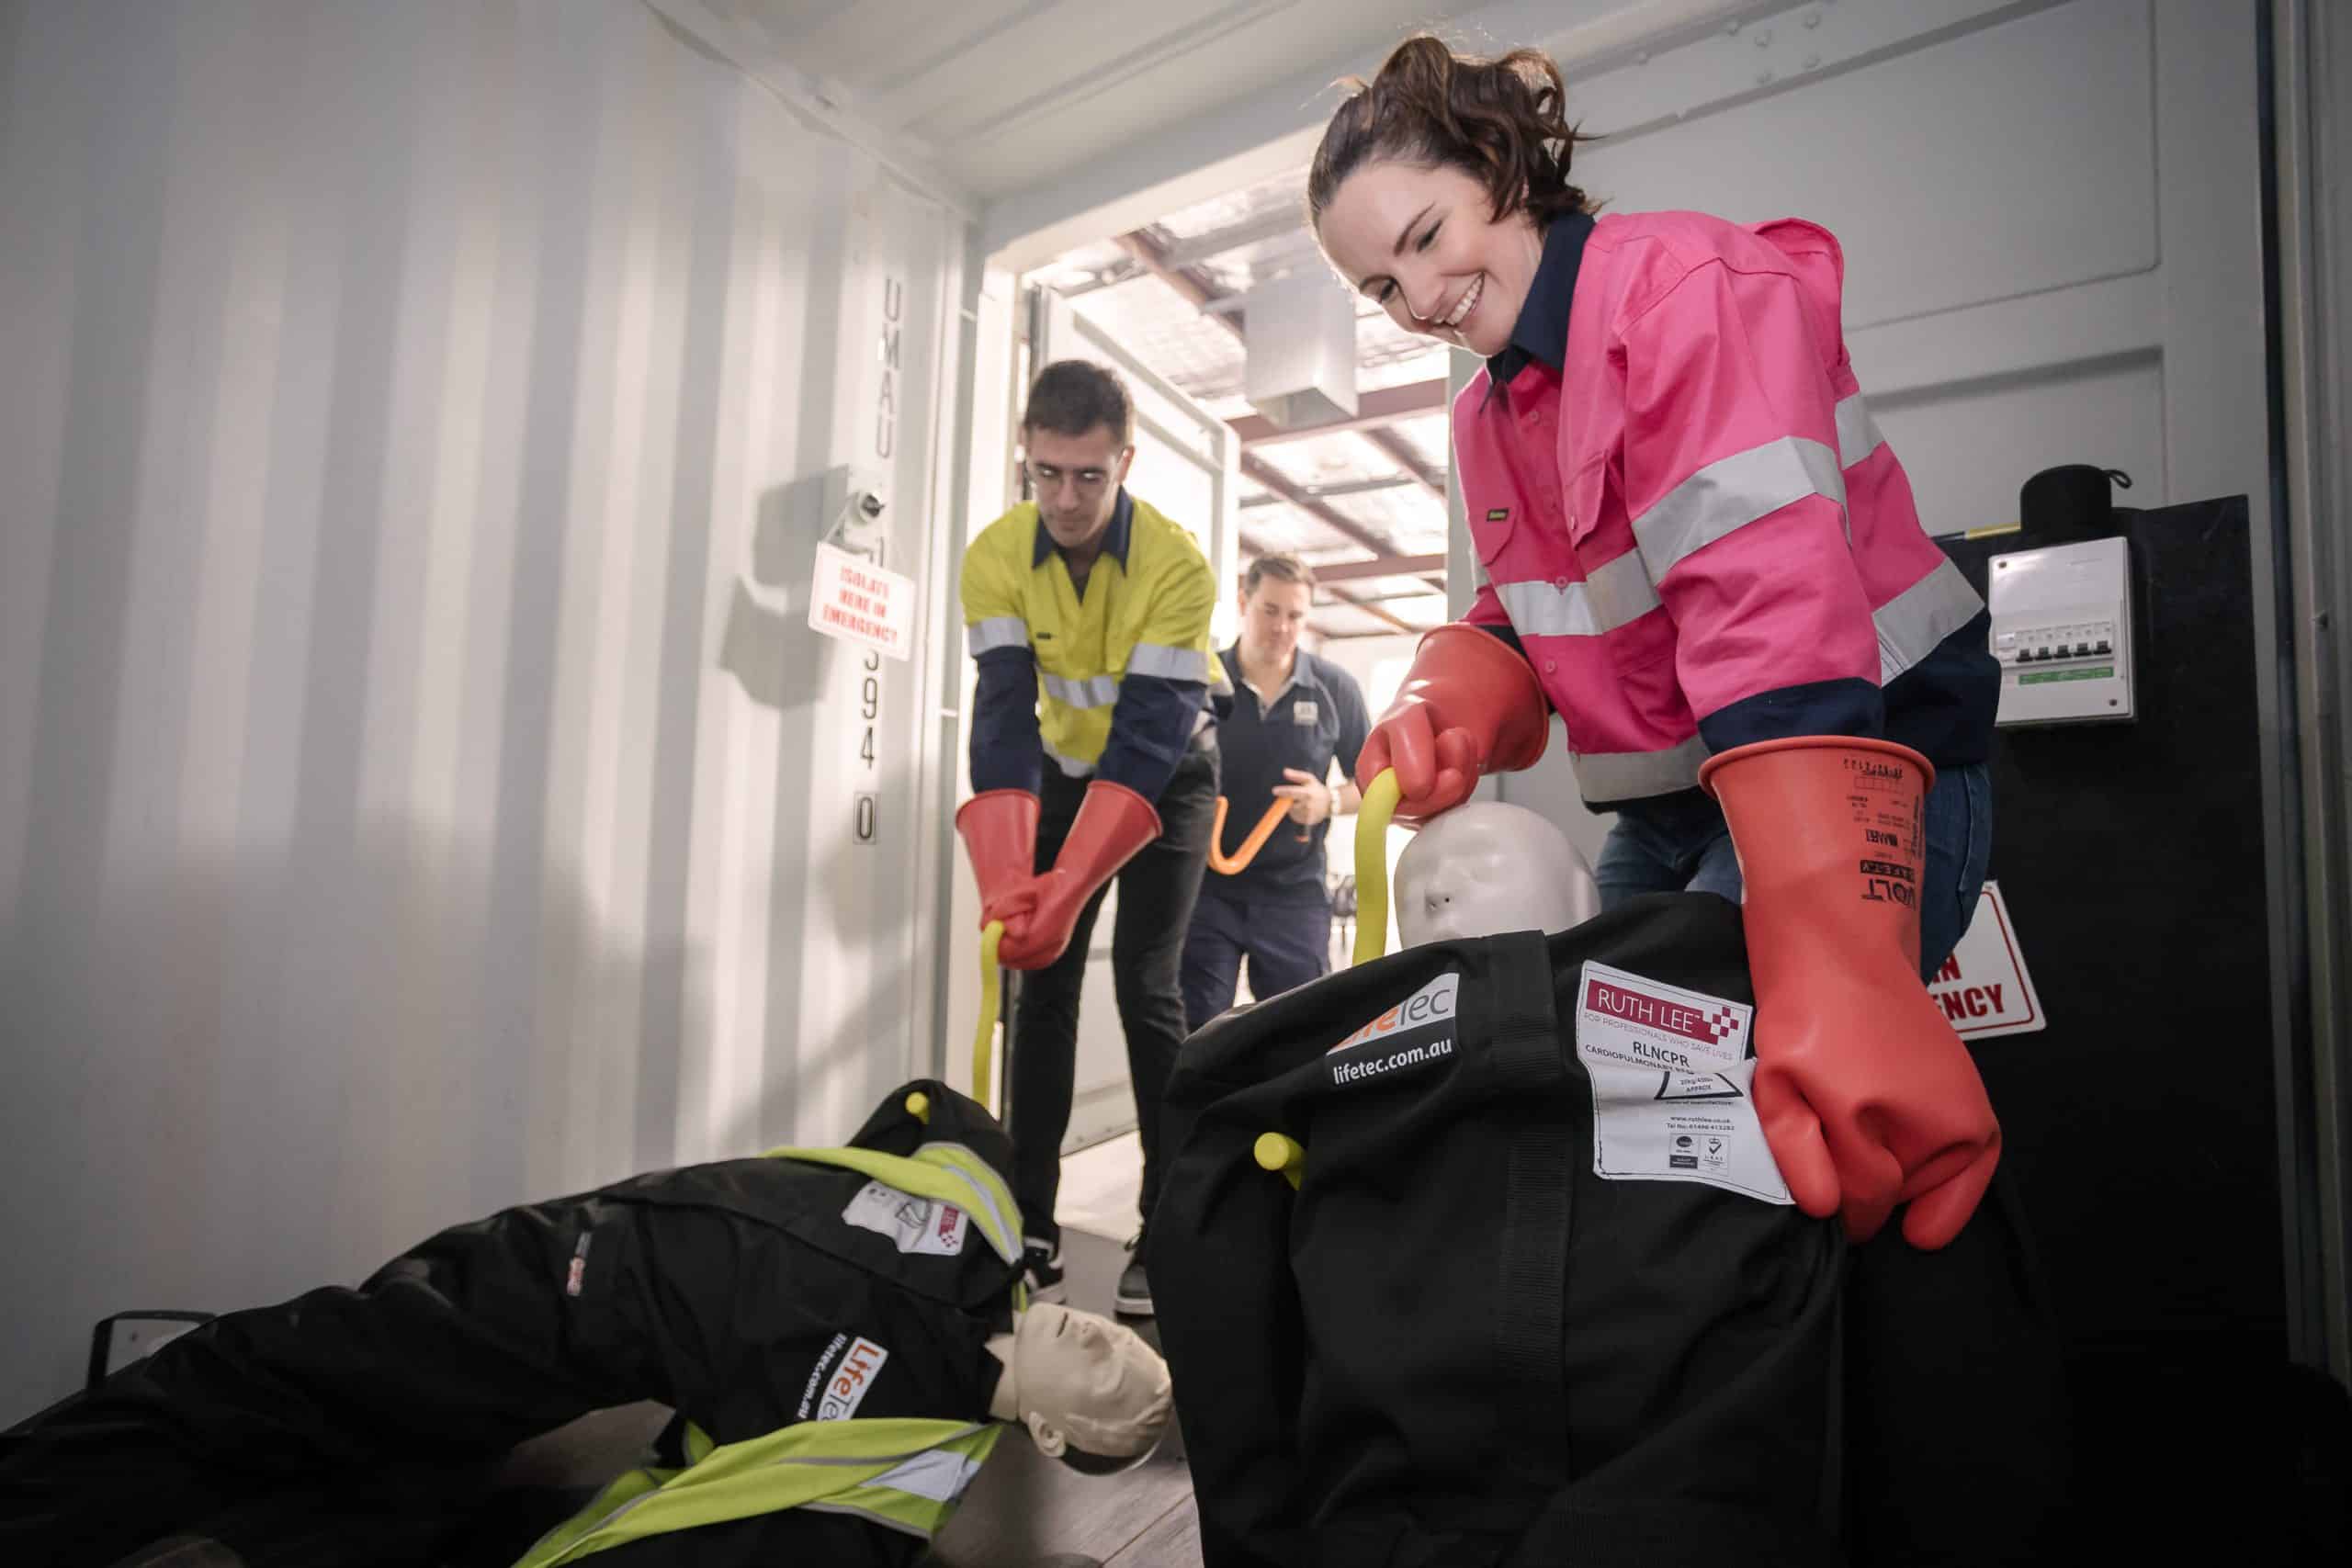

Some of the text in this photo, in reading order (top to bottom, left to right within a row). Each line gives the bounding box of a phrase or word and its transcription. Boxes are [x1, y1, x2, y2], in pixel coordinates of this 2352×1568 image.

[1599, 988, 1653, 1022] RUTH
[1603, 1017, 1668, 1043] PROFESSIONALS
[1333, 1038, 1453, 1085] lifetec.com.au
[1633, 1042, 1690, 1068] RLNCPR
[821, 1344, 879, 1421] LifeTe
